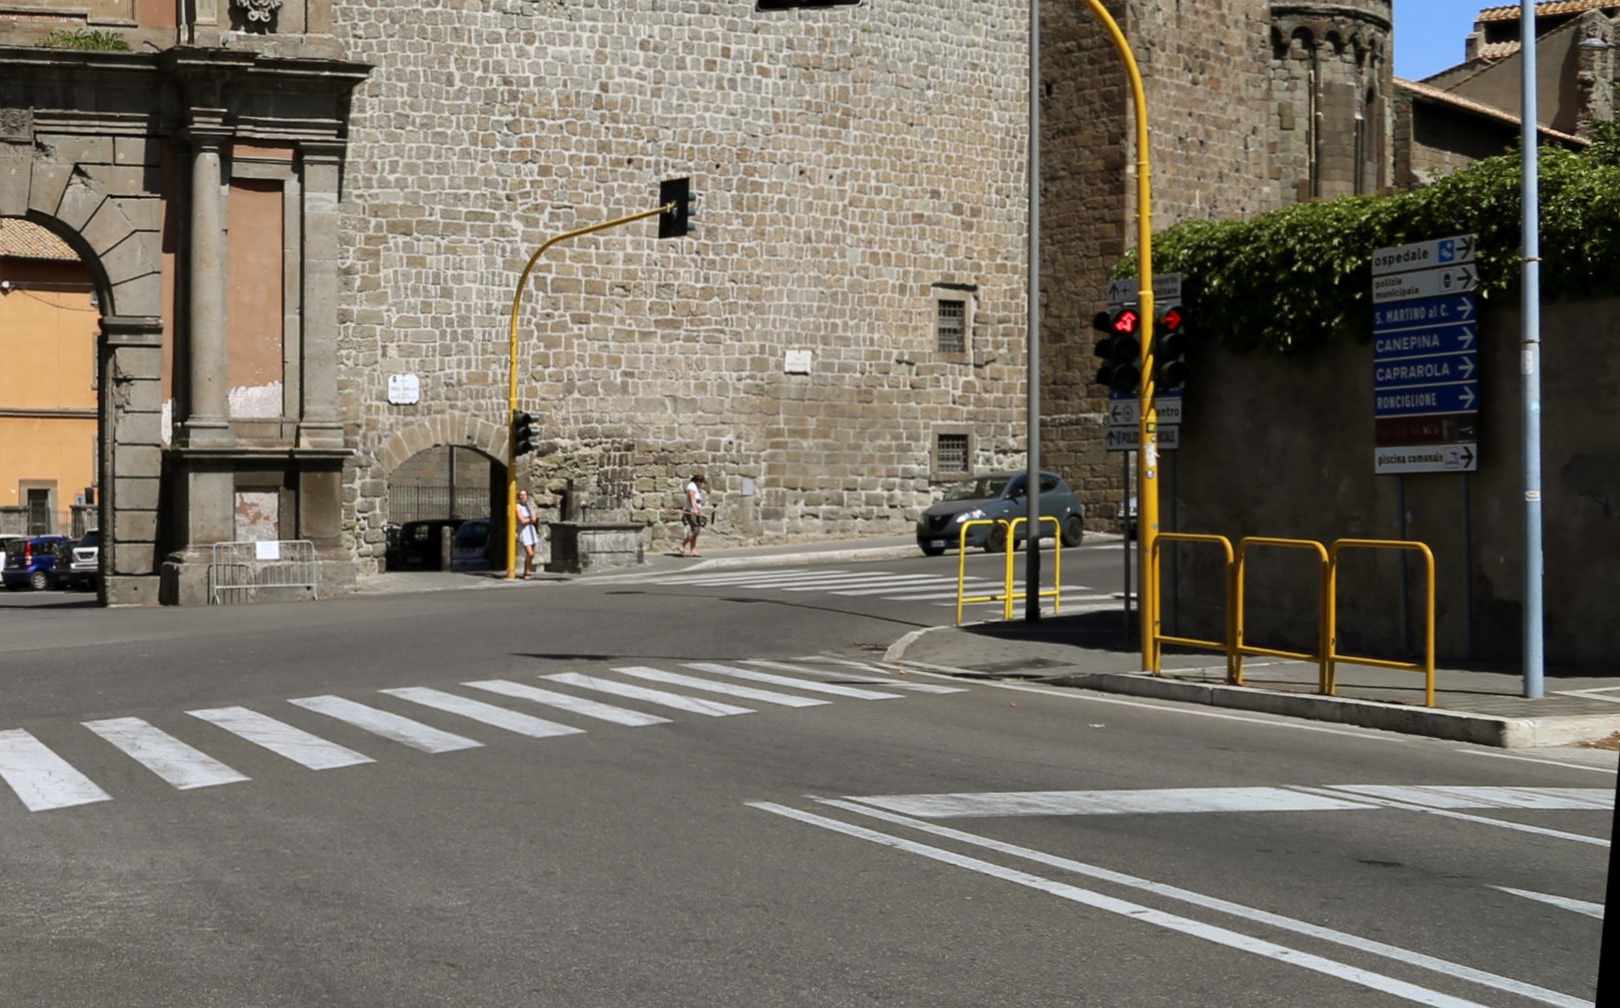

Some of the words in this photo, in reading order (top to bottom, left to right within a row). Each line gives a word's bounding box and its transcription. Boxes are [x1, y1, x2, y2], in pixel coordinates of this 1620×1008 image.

[1374, 248, 1429, 266] ospedale
[1375, 277, 1402, 289] polizia
[1375, 287, 1419, 299] municipale
[1375, 311, 1384, 324] S.
[1386, 306, 1425, 323] MARTINO
[1428, 305, 1438, 318] al
[1440, 304, 1450, 317] C.
[1376, 333, 1440, 353] CANEPINA
[1376, 362, 1450, 382] CAPRAROLA
[1377, 392, 1437, 409] RONCIGLIONE
[1157, 405, 1180, 417] entro
[1378, 452, 1406, 466] piscina
[1408, 451, 1443, 464] comunale
